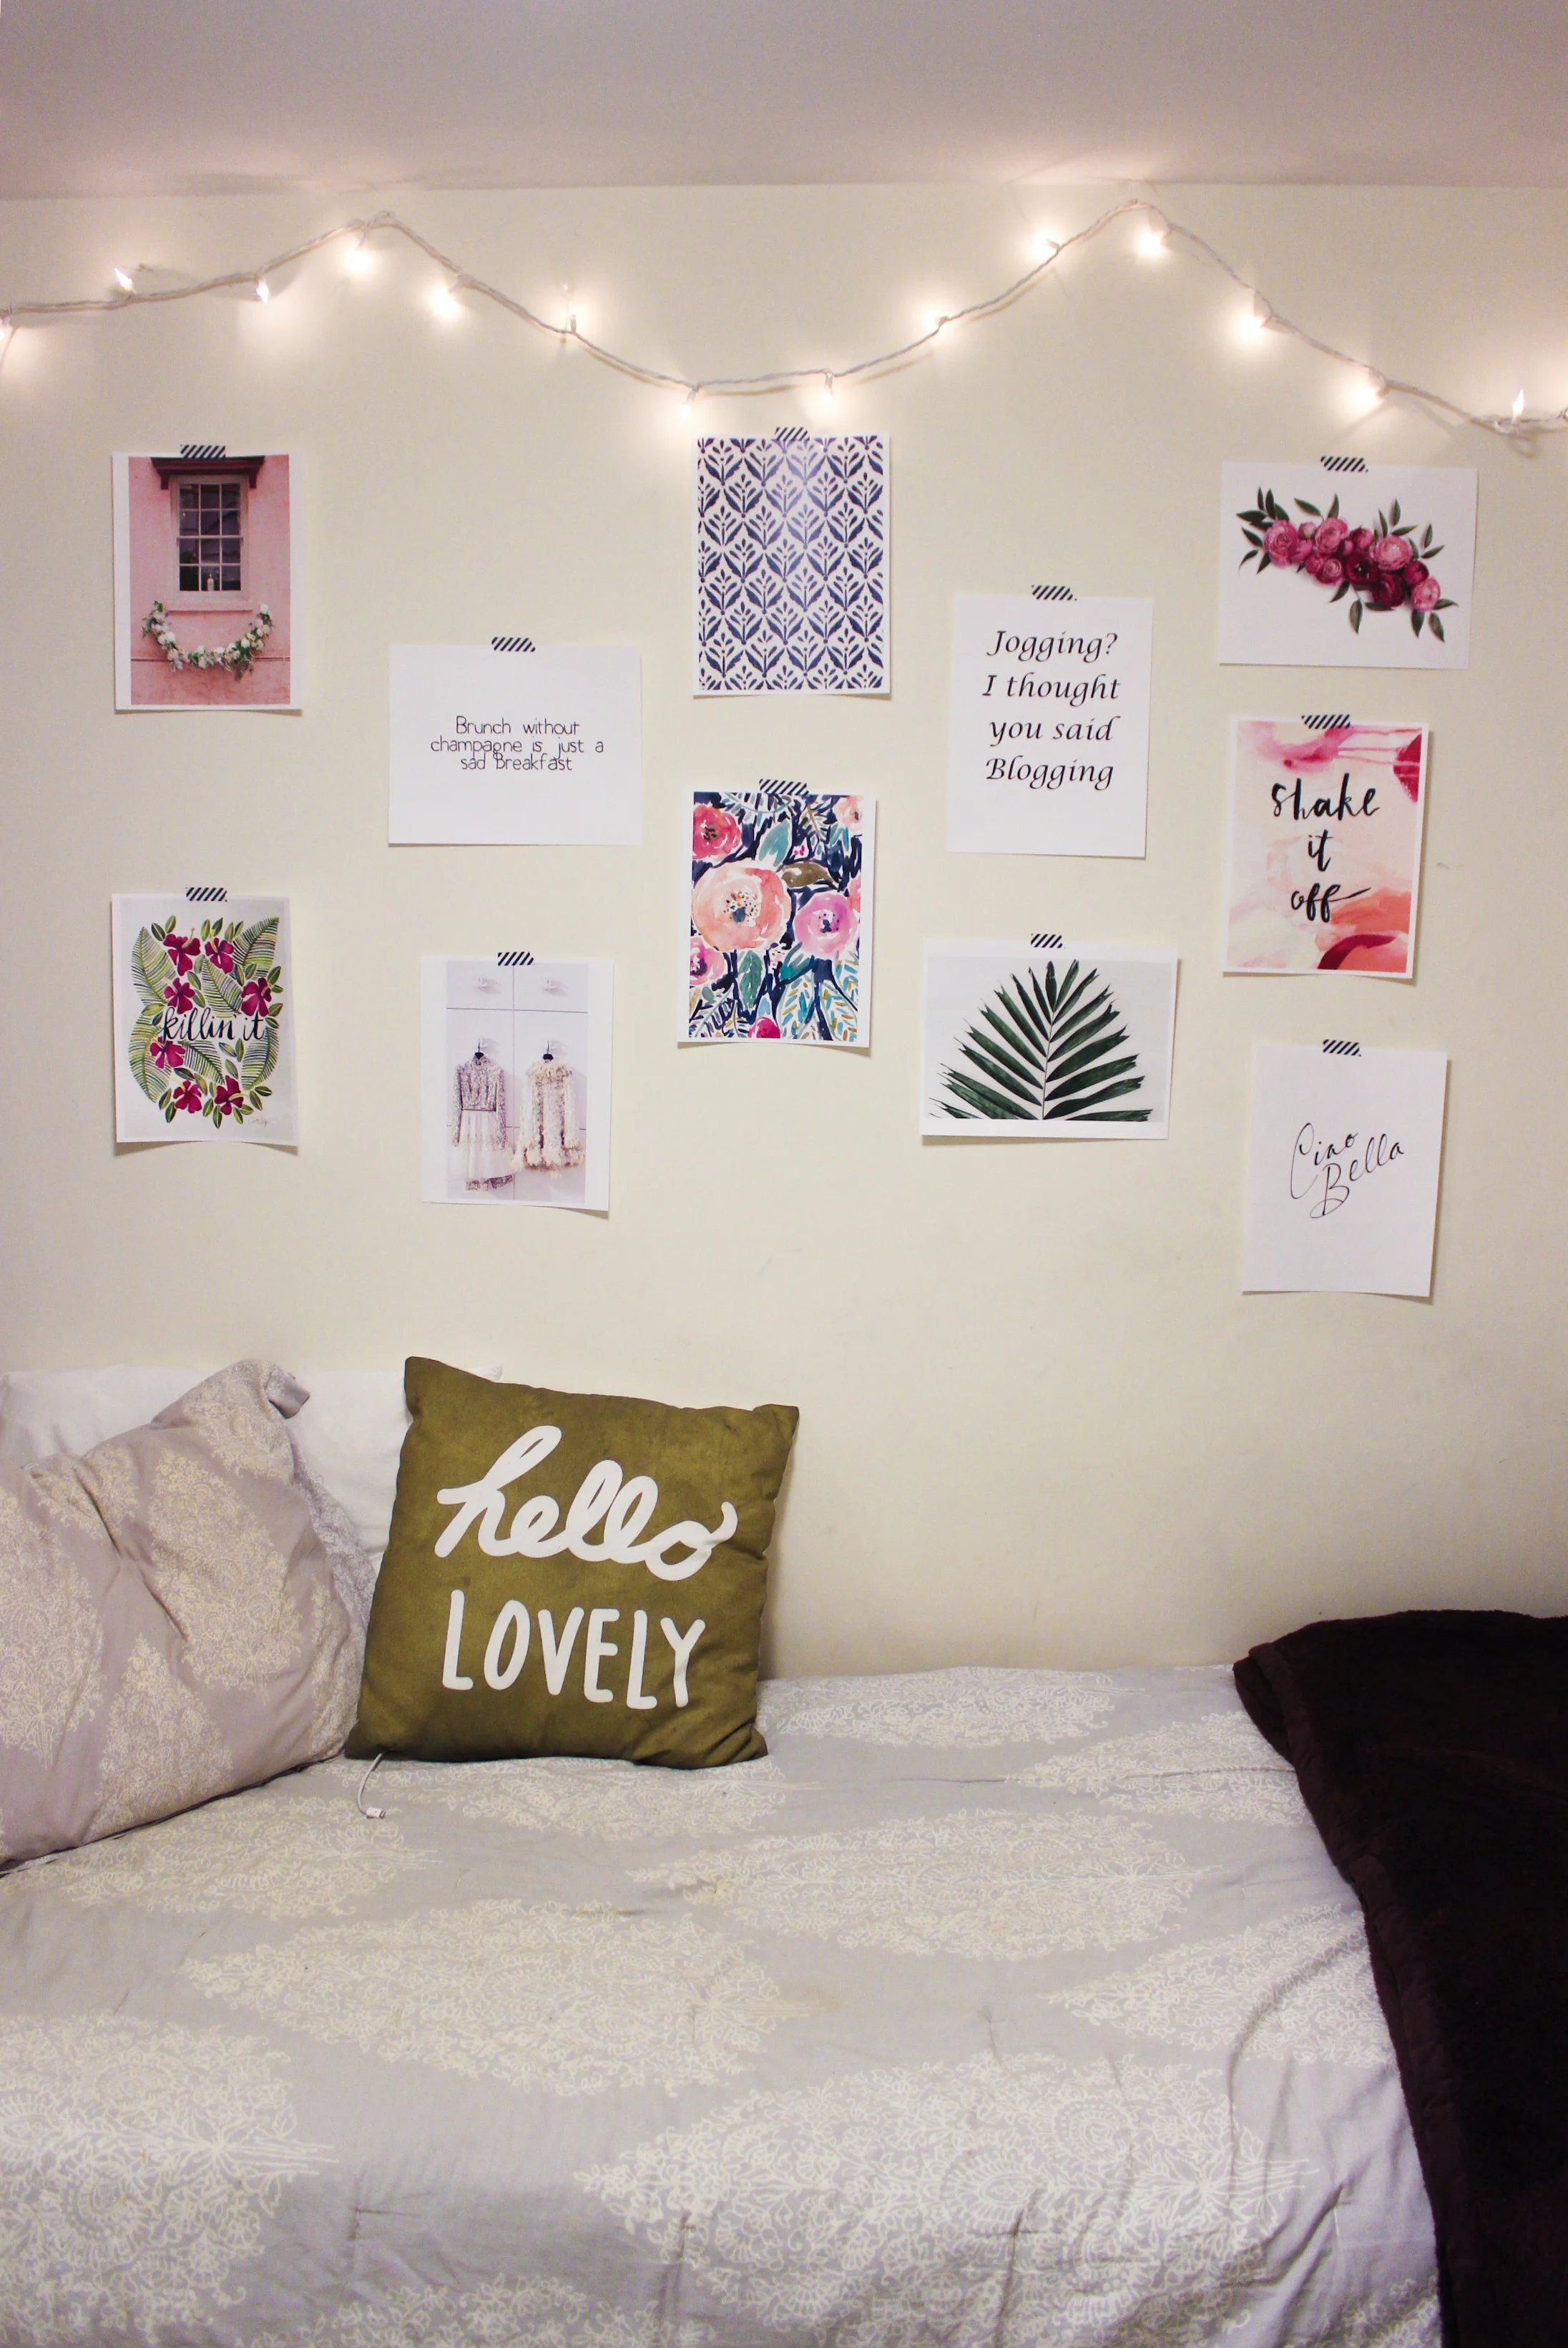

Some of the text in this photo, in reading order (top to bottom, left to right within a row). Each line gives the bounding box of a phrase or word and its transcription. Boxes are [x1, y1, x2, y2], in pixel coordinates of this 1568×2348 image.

[986, 630, 1118, 662] Jogging?
[982, 672, 1121, 707] I thought
[456, 715, 580, 735] Brunch without
[989, 715, 1121, 747] you said
[431, 735, 604, 760] champagne is just a
[461, 753, 573, 771] sad Breakfast
[986, 755, 1114, 791] Blogging
[1271, 773, 1380, 821] shake
[1308, 830, 1333, 872] it
[1290, 883, 1371, 923] off
[160, 1007, 267, 1042] killin' it
[1290, 1122, 1358, 1200] Ciao
[1310, 1133, 1404, 1218] Bella
[433, 1425, 738, 1581] hello
[442, 1589, 706, 1710] LOVELY
